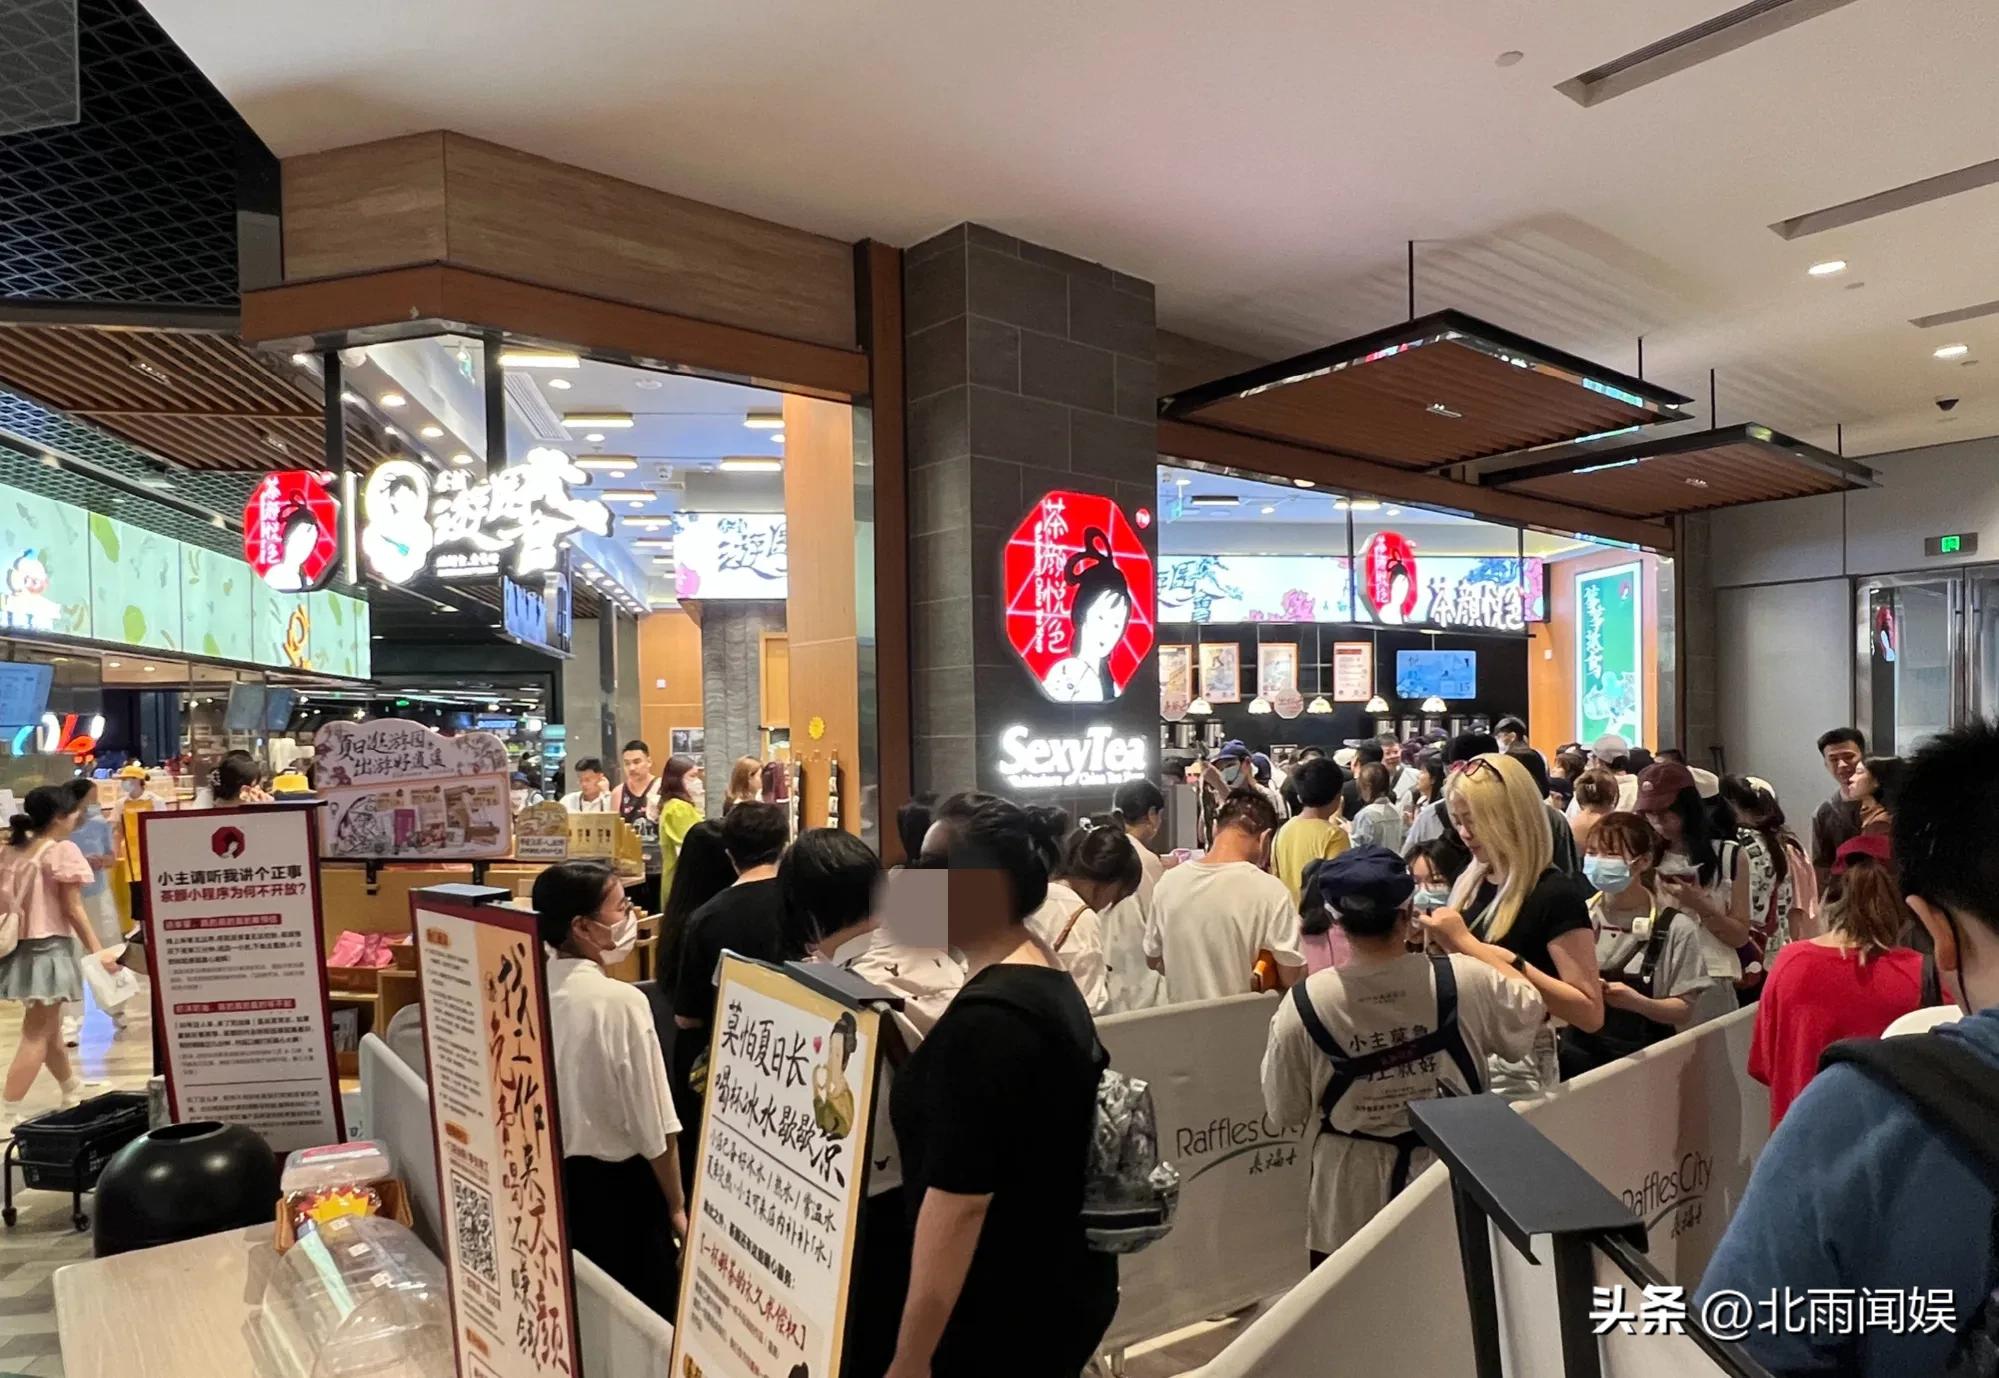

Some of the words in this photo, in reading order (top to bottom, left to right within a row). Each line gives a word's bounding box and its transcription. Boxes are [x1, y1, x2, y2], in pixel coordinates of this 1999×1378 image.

[1000, 725, 1146, 779] SexyTea
[157, 864, 303, 887] 小主请听我讲个正事
[721, 999, 810, 1089] 莫怕夏日长
